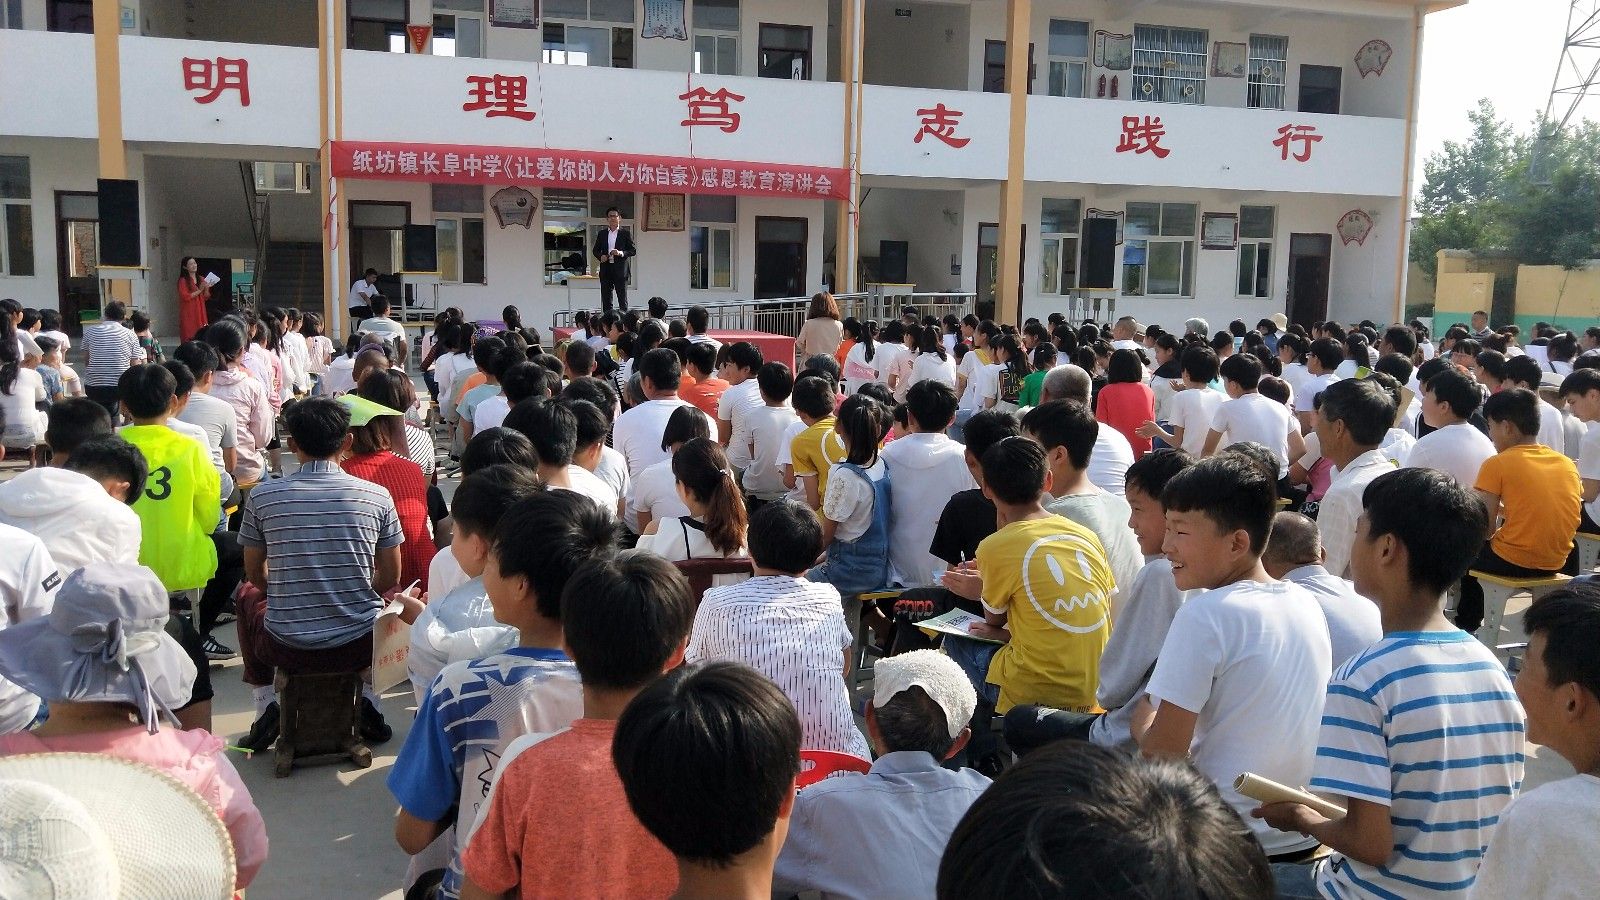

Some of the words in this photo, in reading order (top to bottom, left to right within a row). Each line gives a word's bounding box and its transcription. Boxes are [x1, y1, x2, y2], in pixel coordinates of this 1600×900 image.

[182, 57, 250, 106] 明
[463, 74, 535, 121] 理
[679, 87, 745, 133] 笃
[914, 103, 971, 149] 志
[1116, 115, 1170, 158] 践
[1273, 123, 1322, 162] 行
[145, 466, 171, 500] 3
